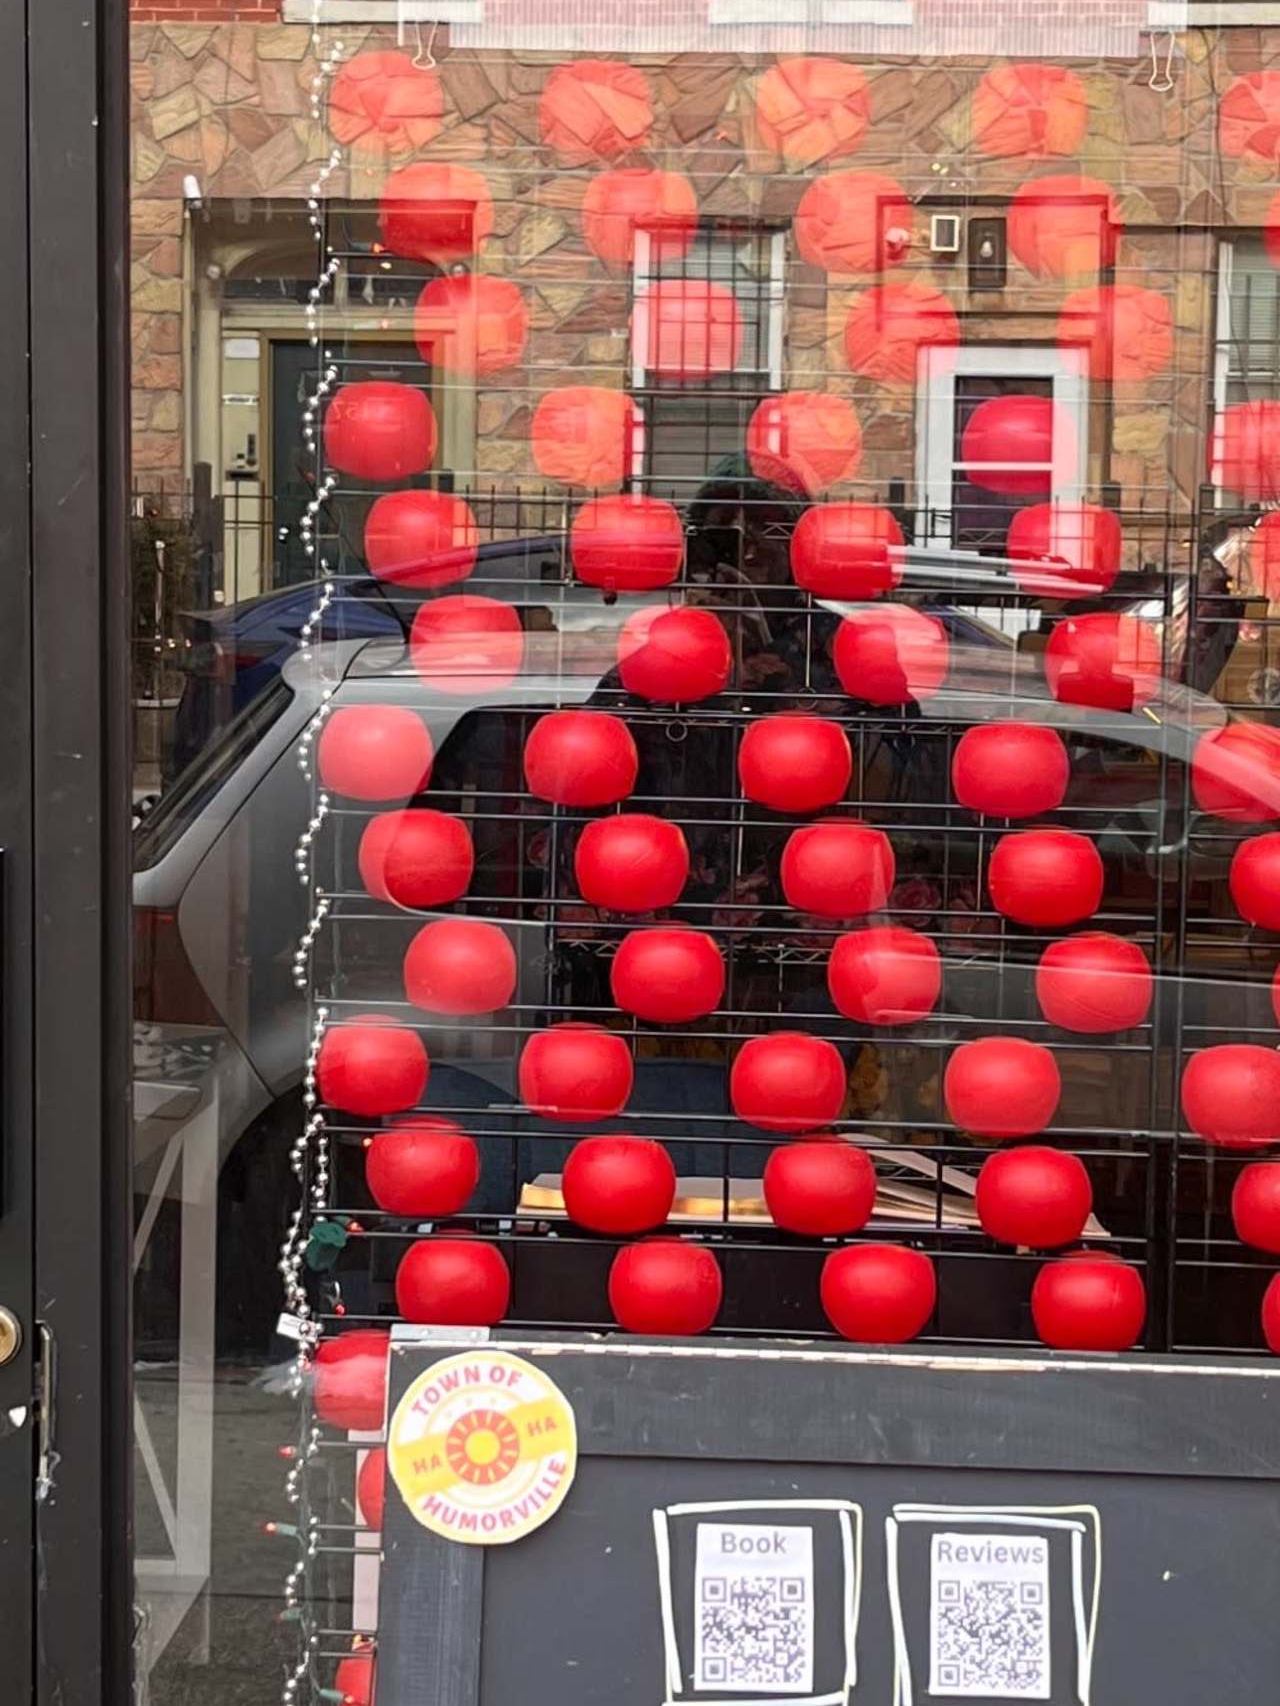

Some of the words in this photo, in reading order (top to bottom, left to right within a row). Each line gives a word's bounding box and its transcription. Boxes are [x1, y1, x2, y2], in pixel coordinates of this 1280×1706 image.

[411, 1365, 480, 1416] TOWN
[488, 1364, 524, 1387] OF
[412, 1453, 443, 1476] HA
[526, 1415, 558, 1438] HA
[422, 1458, 567, 1532] HUMORVILLE
[720, 1531, 788, 1555] Book
[936, 1540, 1044, 1565] Reviews
